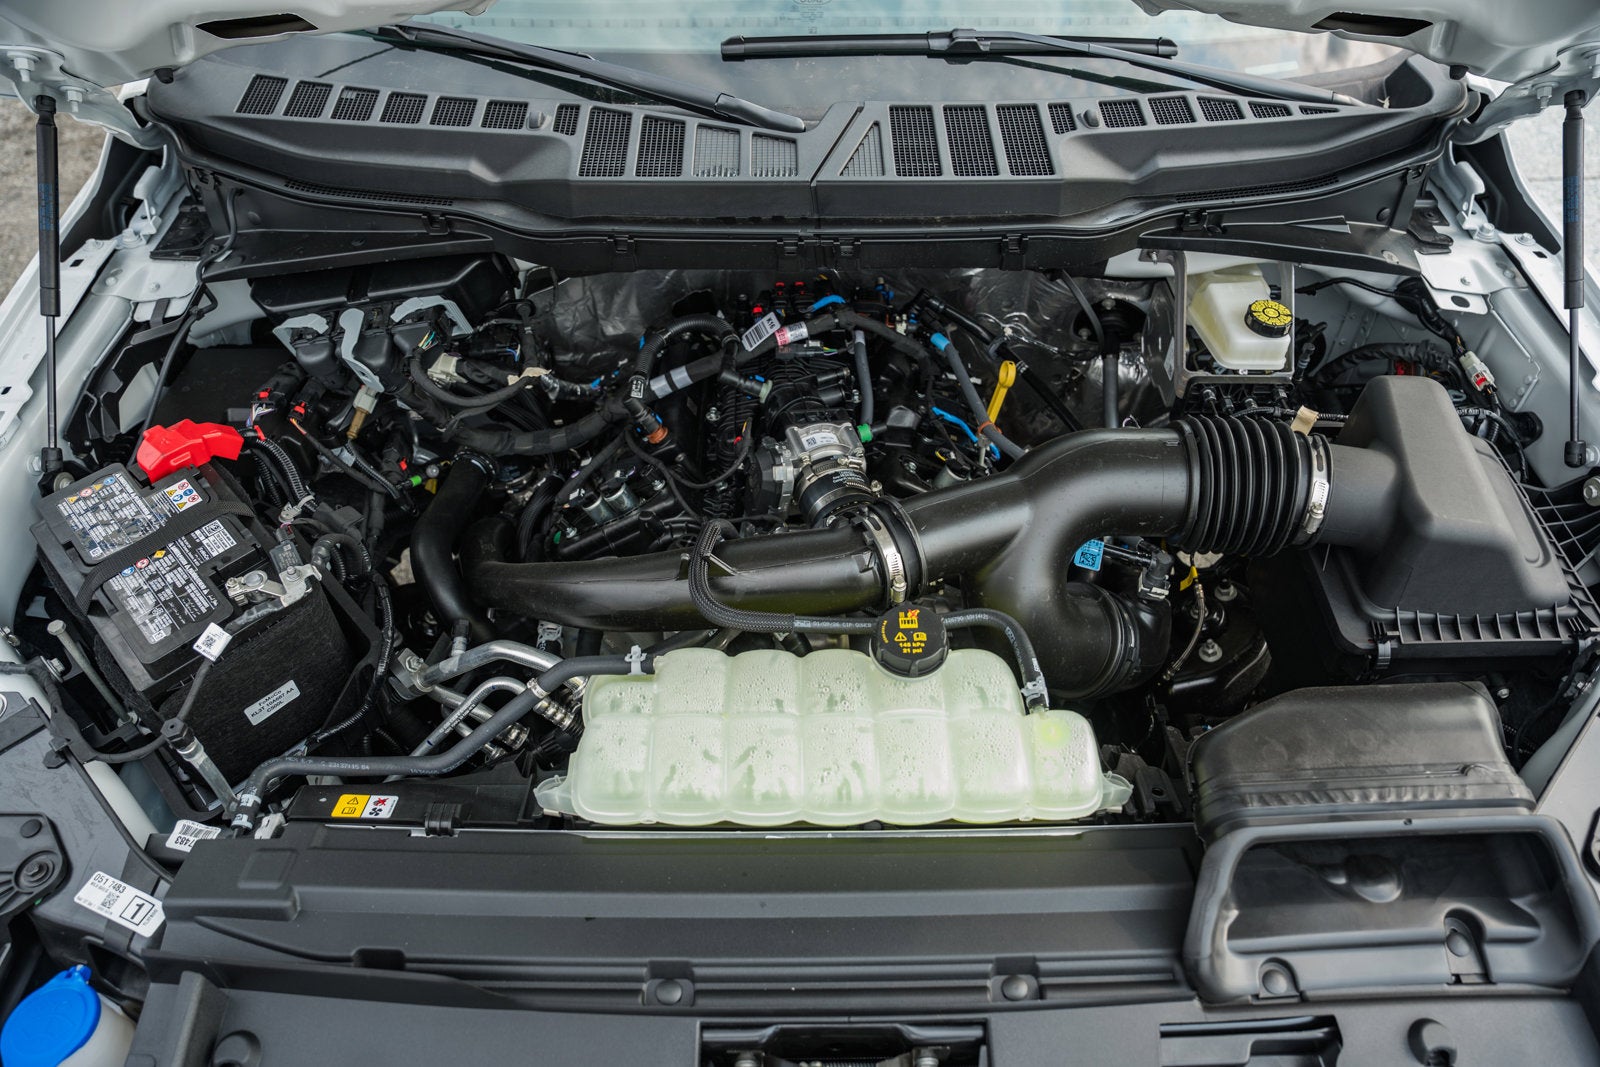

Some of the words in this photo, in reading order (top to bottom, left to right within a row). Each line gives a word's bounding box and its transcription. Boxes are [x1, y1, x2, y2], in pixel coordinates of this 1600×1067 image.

[259, 690, 282, 706] FoMoCo
[251, 705, 265, 717] KL3T
[93, 873, 109, 885] 051
[108, 880, 127, 894] 7483
[130, 902, 145, 920] 1
